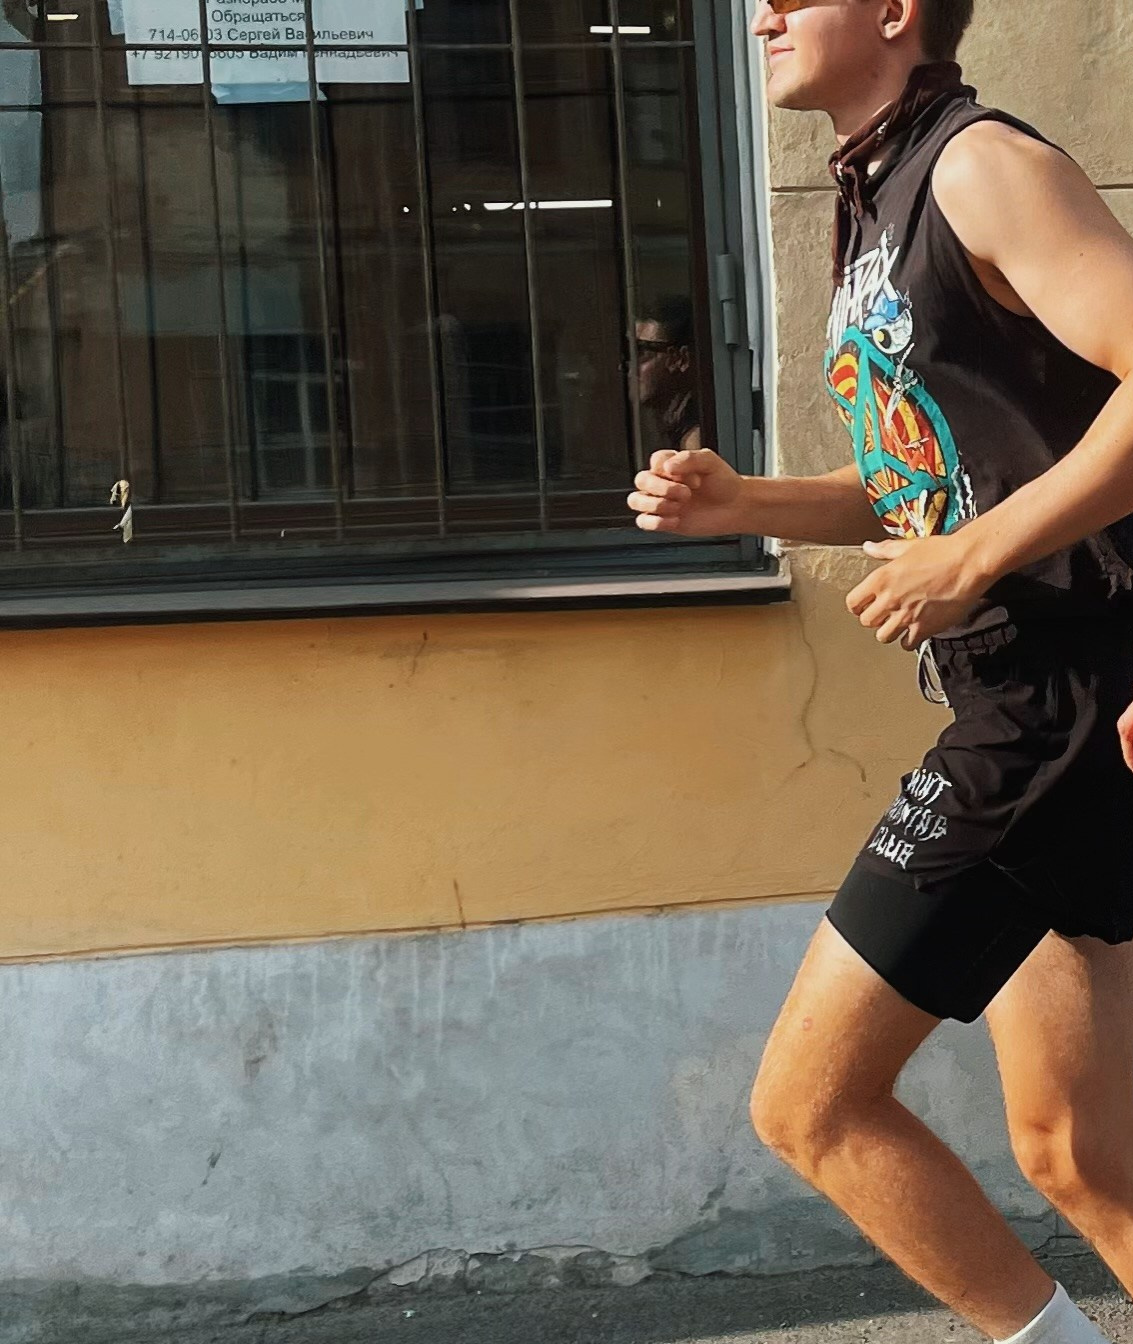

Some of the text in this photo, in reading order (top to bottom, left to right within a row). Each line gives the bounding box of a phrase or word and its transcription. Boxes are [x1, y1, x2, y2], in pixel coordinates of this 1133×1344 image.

[149, 27, 374, 43] 714-0603 Сергей Ваильевич
